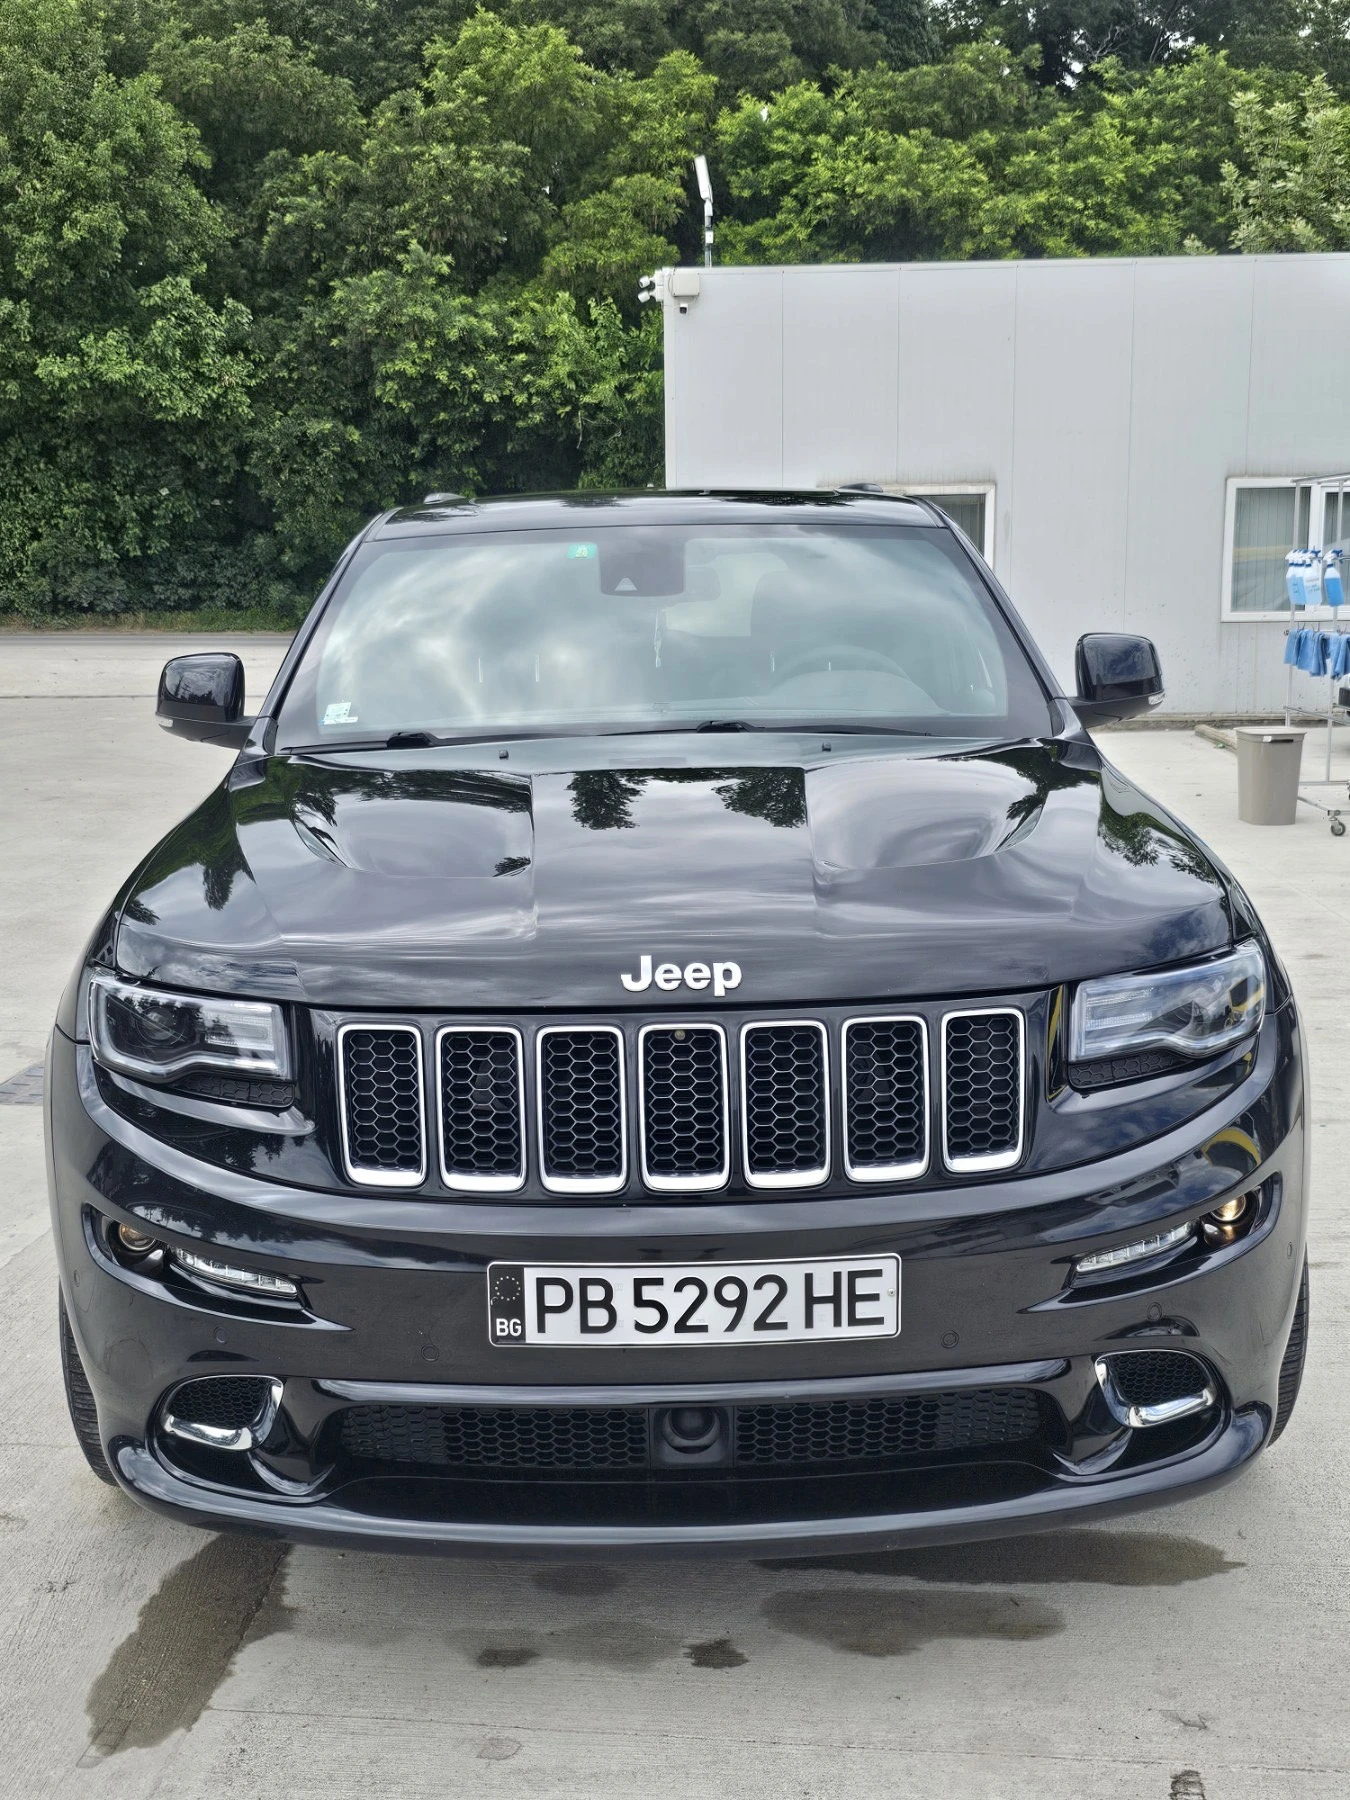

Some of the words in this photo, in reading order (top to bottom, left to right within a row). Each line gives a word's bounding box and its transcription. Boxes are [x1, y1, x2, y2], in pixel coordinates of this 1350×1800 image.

[620, 954, 743, 997] Jeep
[632, 1273, 789, 1335] 5292
[495, 1318, 522, 1337] BG
